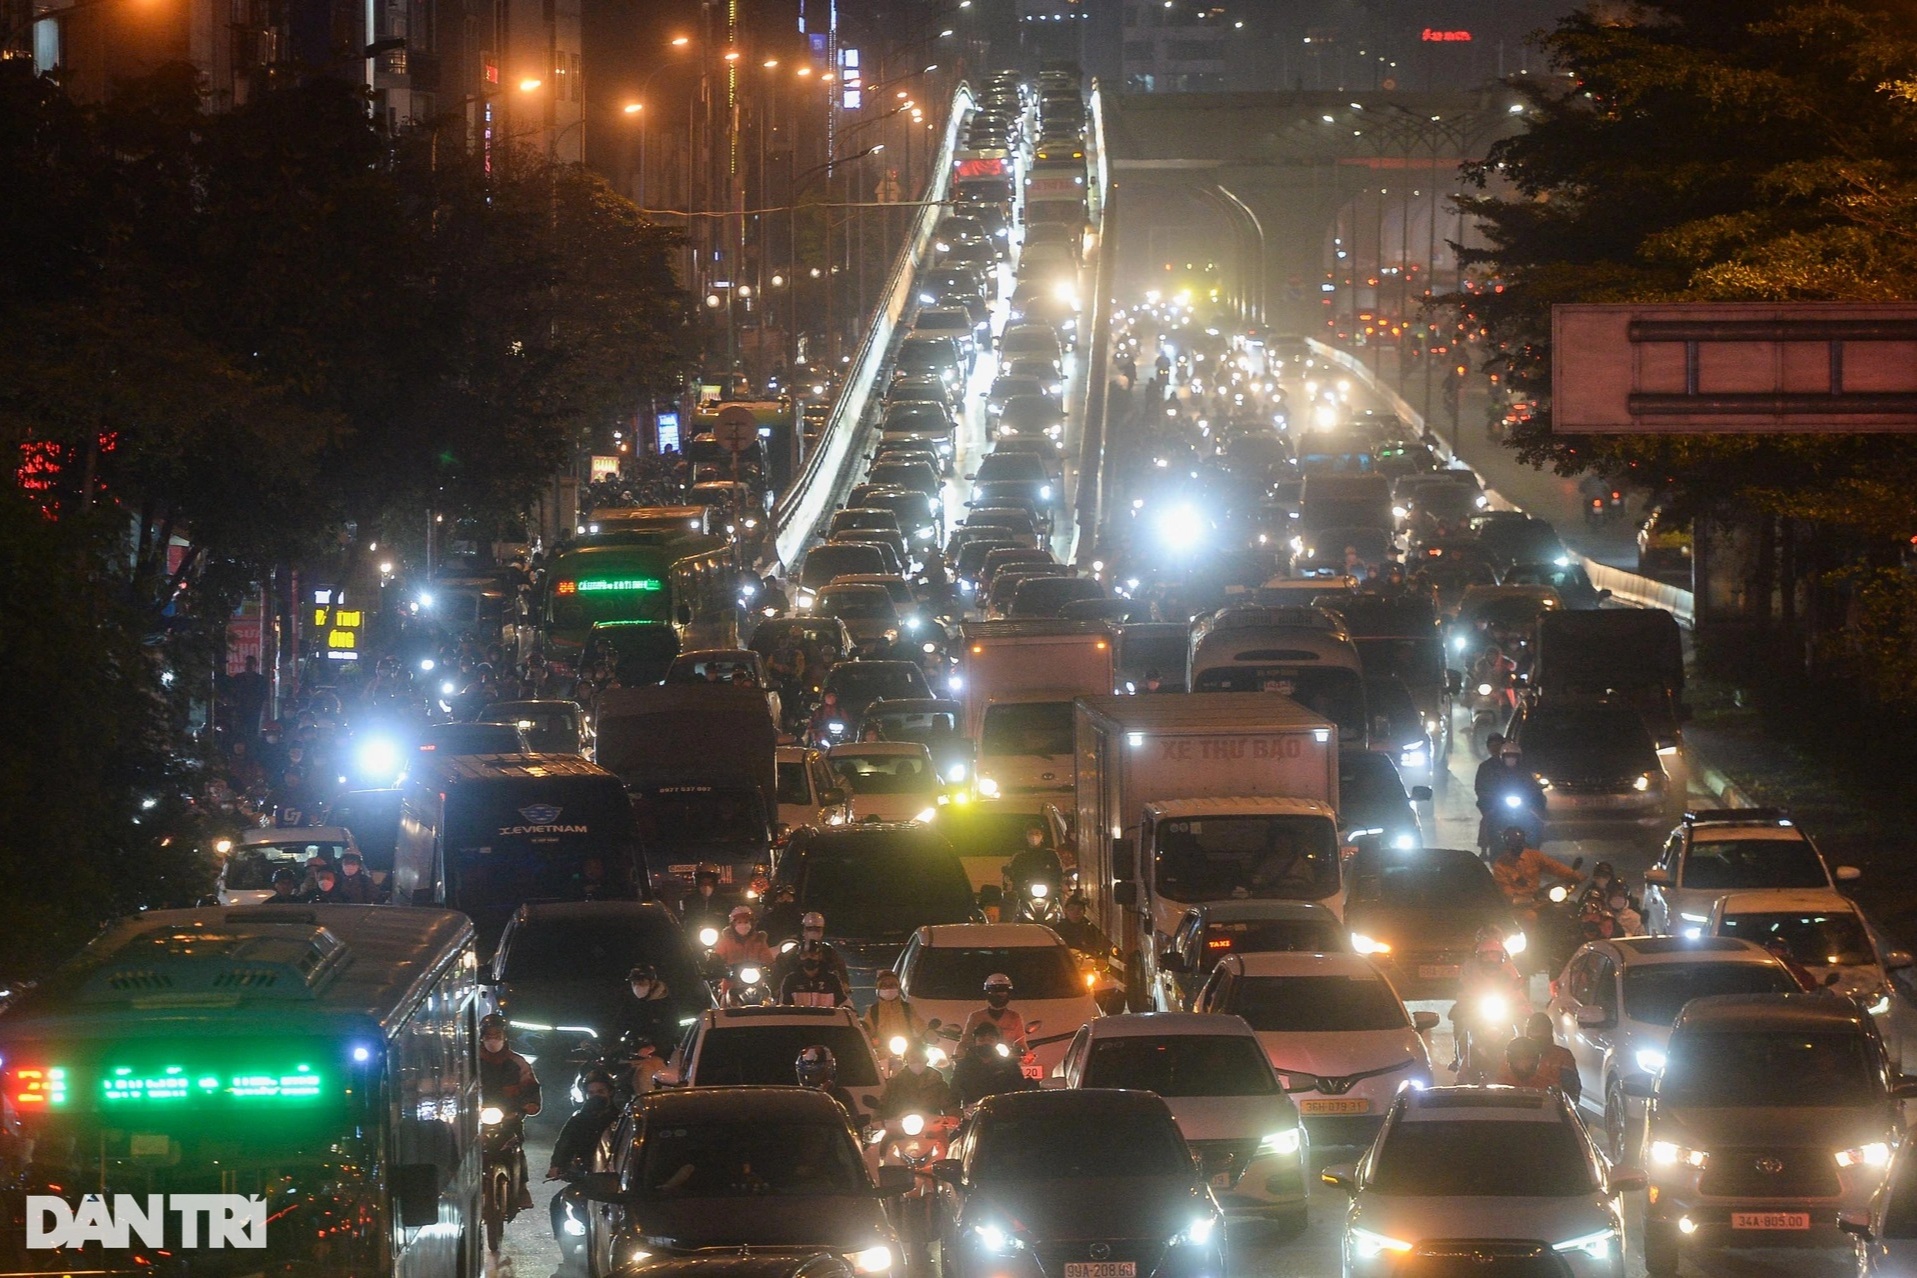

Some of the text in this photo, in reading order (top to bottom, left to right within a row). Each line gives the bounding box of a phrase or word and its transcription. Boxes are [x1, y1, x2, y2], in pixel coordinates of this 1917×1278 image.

[1160, 740, 1191, 760] XE
[1200, 738, 1248, 760] THƯ
[1209, 940, 1231, 948] TAXI
